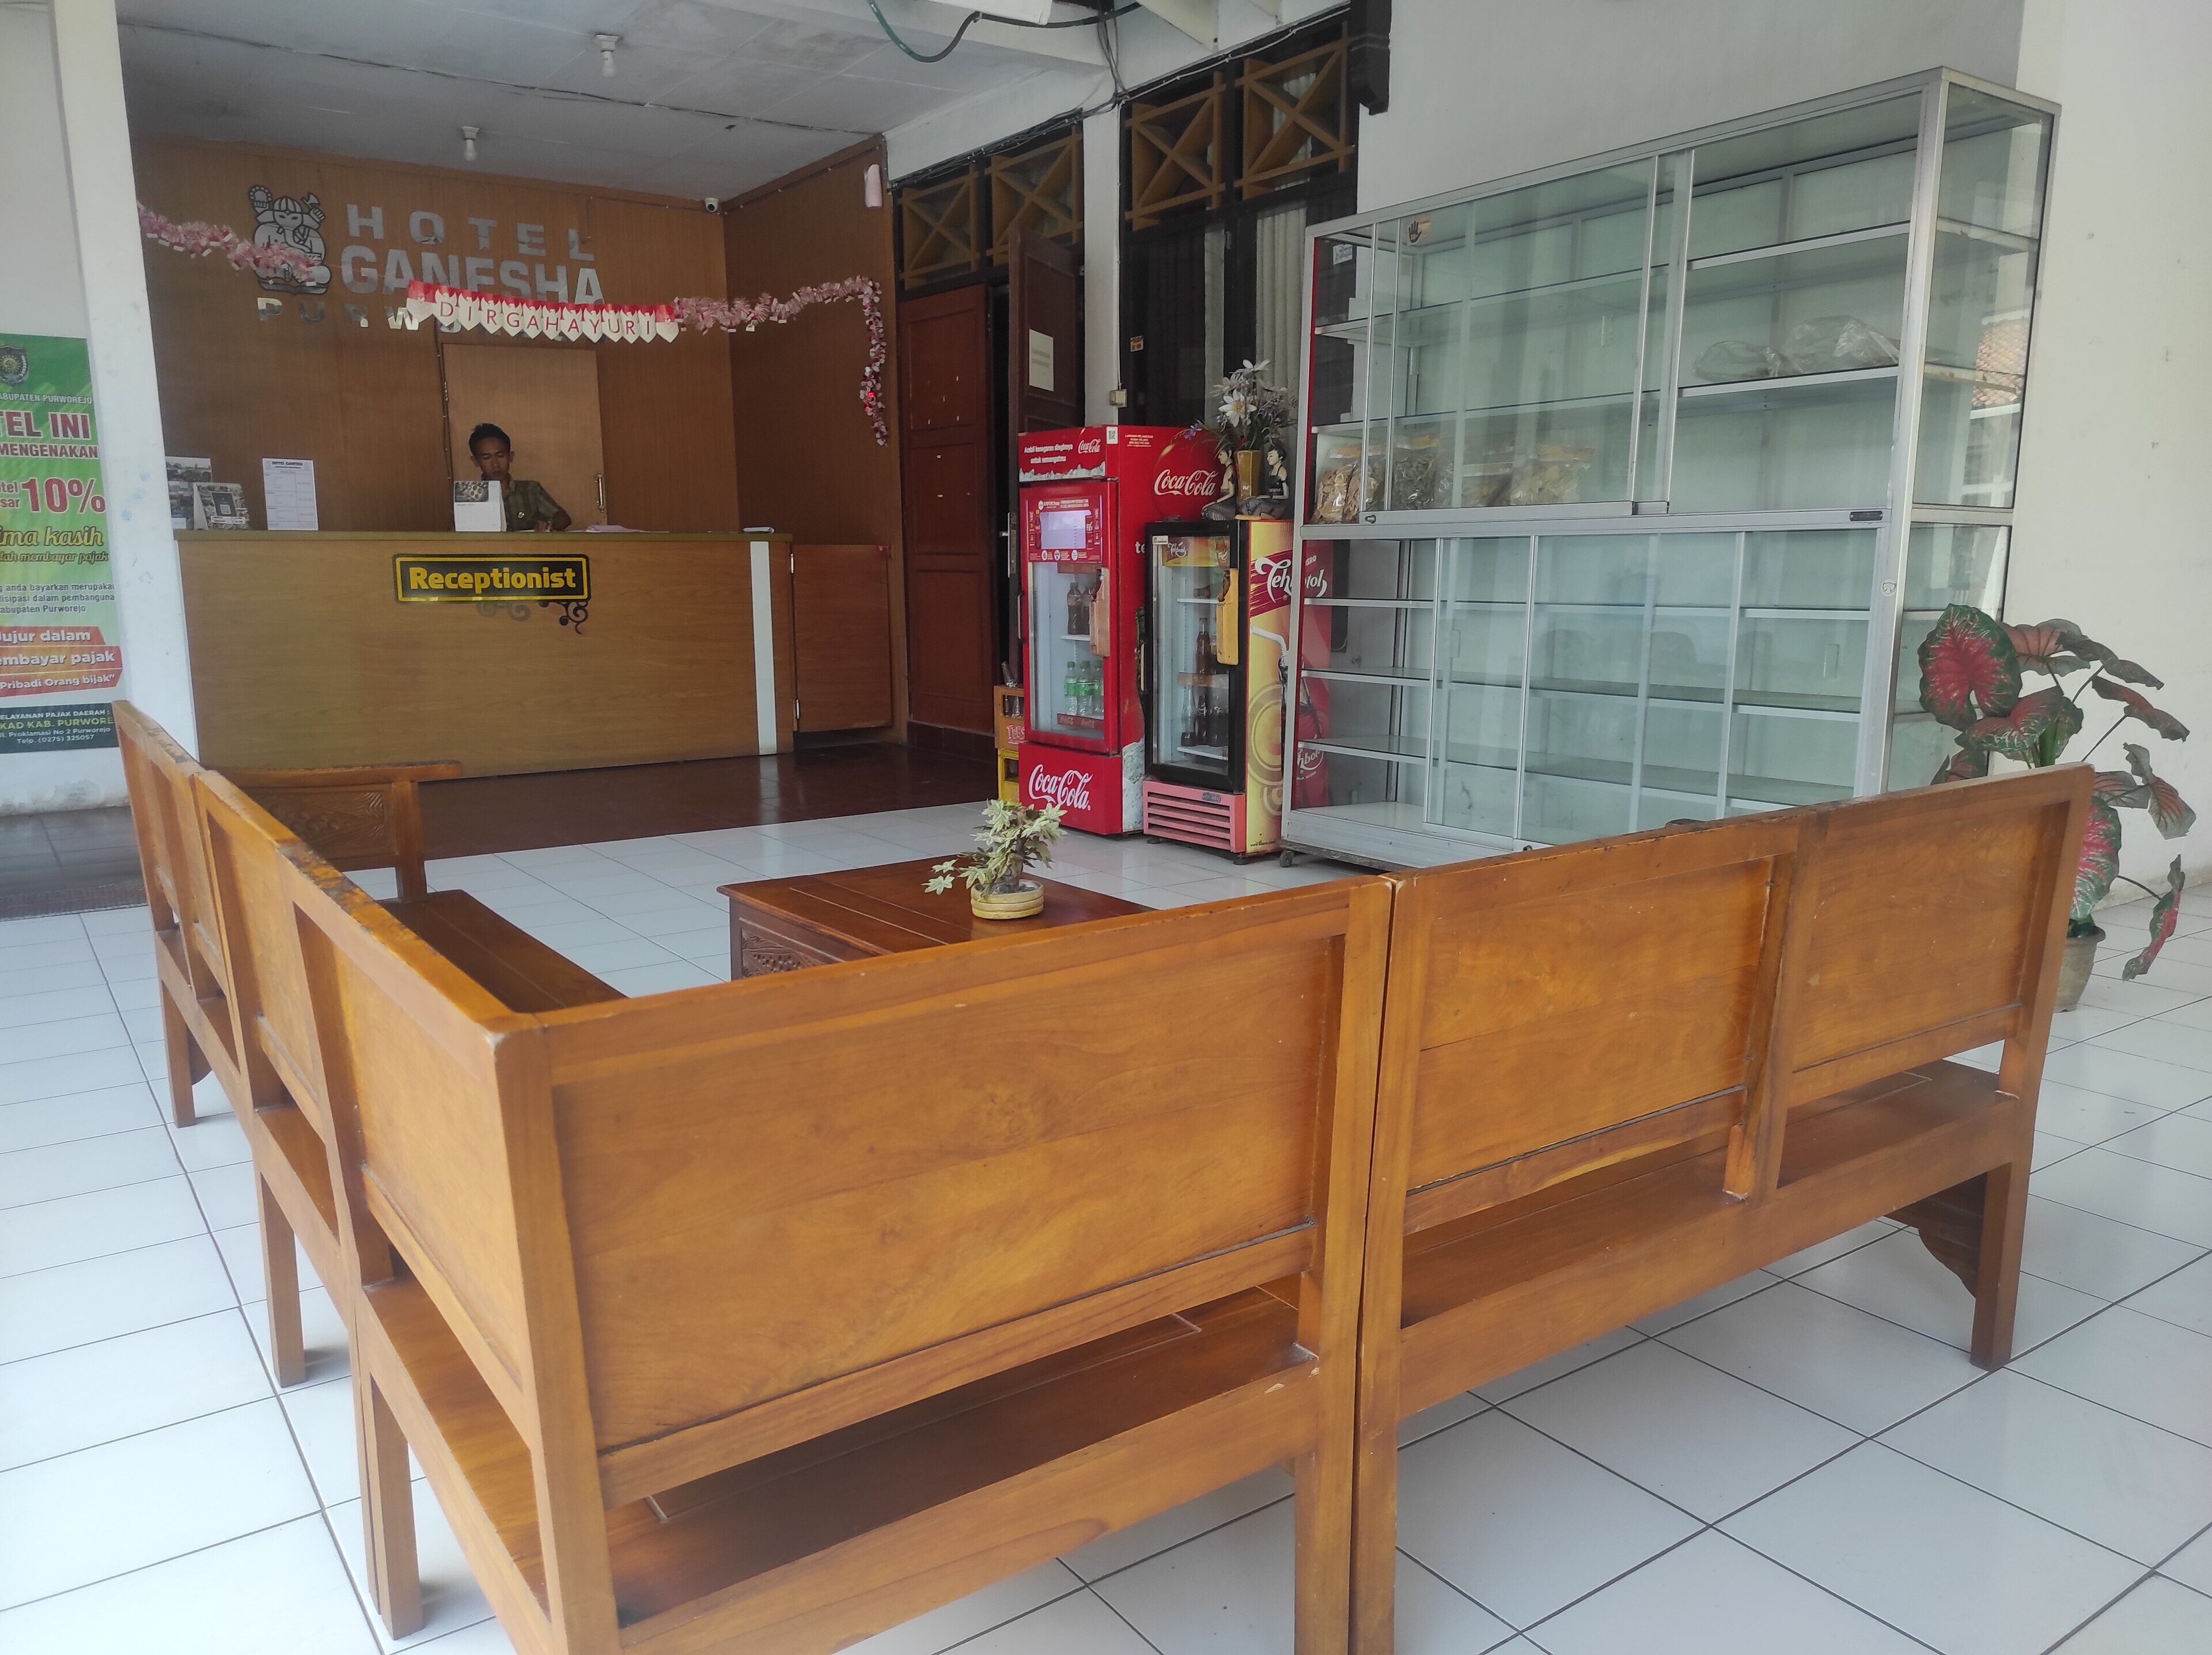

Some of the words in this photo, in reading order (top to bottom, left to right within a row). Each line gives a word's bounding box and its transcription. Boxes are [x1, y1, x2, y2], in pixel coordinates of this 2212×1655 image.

[347, 203, 594, 262] HOTEL
[341, 245, 605, 305] GANESHA
[0, 392, 40, 402] ABUPATEN
[43, 395, 92, 404] PURWOREJO
[48, 412, 92, 440] INI
[21, 478, 106, 513] 10%
[44, 525, 104, 546] kasih
[20, 551, 78, 565] membayar
[78, 551, 109, 565] pajak
[30, 583, 69, 592] bayarkan
[409, 567, 576, 594] Receptionist
[43, 605, 86, 613] Purworejo
[40, 630, 91, 642] dalam
[71, 650, 115, 665] pajak
[44, 677, 80, 687] Orang
[73, 726, 111, 734] Purworejo
